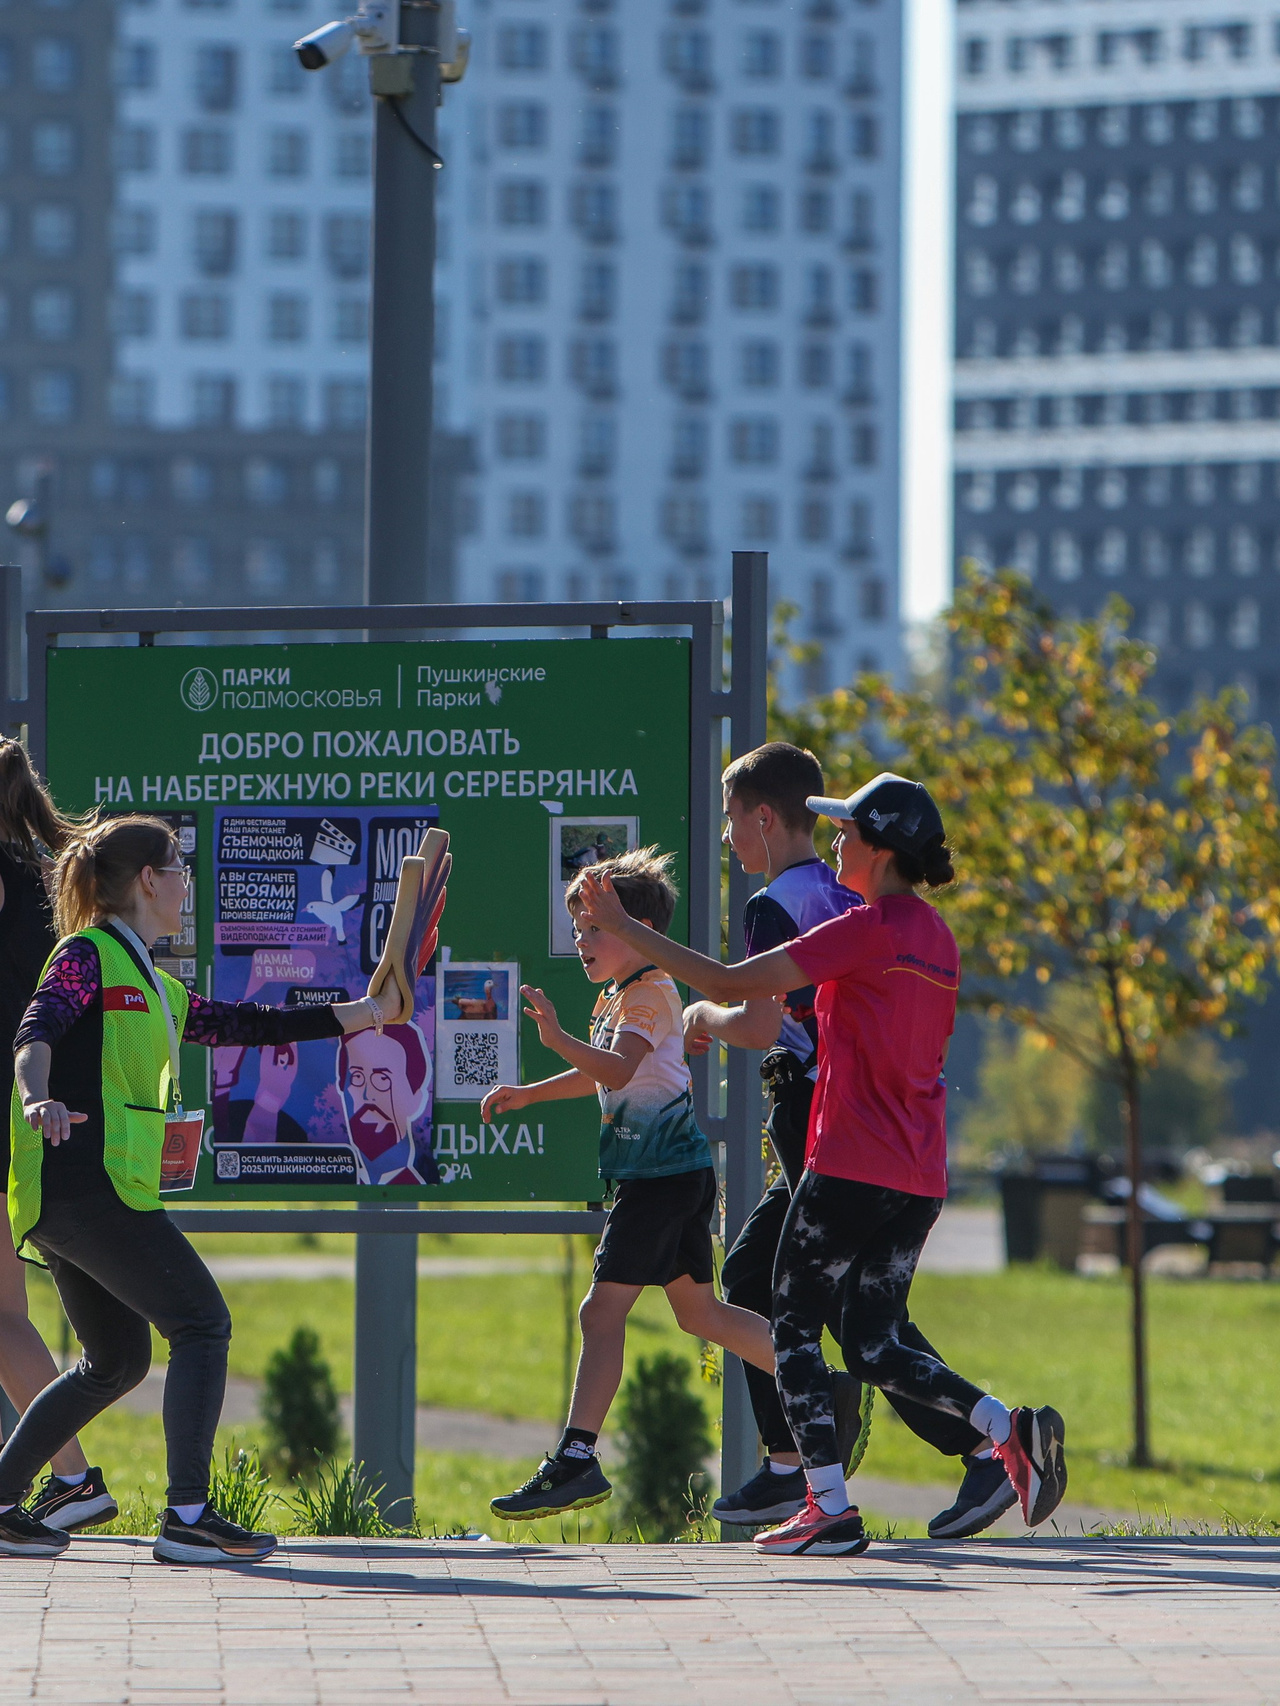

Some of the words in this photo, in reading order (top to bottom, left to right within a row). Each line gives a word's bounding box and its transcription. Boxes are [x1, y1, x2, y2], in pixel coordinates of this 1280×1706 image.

[222, 667, 291, 686] ПАРКИ
[417, 665, 546, 686] Пушкинские
[222, 688, 382, 709] ПОДМОСКОВЬЯ
[417, 689, 481, 710] Парки
[198, 731, 304, 763] ДОБРО
[313, 728, 520, 758] ПОЖАЛОВАТЬ
[94, 775, 133, 802] НА
[142, 772, 352, 802] НАБЕРЕЖНУЮ
[359, 771, 435, 799] РЕКИ
[443, 768, 639, 798] СЕРЕБРЯНКА
[222, 834, 303, 847] СЪЕМОЧНОЙ
[221, 847, 304, 861] ПЛОЩАДКОЙ!
[219, 873, 228, 882] А
[229, 872, 246, 882] ВЫ
[248, 872, 296, 883] СТАНЕТЕ
[220, 884, 296, 898] ГЕРОЯМИ
[220, 898, 295, 910] ЧЕХОВСКИХ
[221, 910, 294, 921] ПРОИЗВЕДЕНИЙ!
[221, 932, 286, 942] ВИДЕОПОДКАСТ
[288, 933, 294, 941] С
[296, 932, 327, 942] ВАМИ!
[254, 953, 293, 965] МАМА!
[255, 966, 262, 978] Я
[265, 966, 273, 978] В
[276, 966, 315, 979] КИНО!
[294, 991, 301, 1001] 7
[302, 991, 340, 1002] МИНУТ
[430, 1123, 545, 1160] ДЫХА!
[241, 1155, 282, 1164] ОСТАВИТЬ
[283, 1155, 314, 1164] ЗАЯВКУ
[315, 1155, 326, 1164] НА
[327, 1155, 352, 1164] САЙТЕ
[241, 1164, 355, 1175] 2025.ПУШКИНОФЕСТ.РФ
